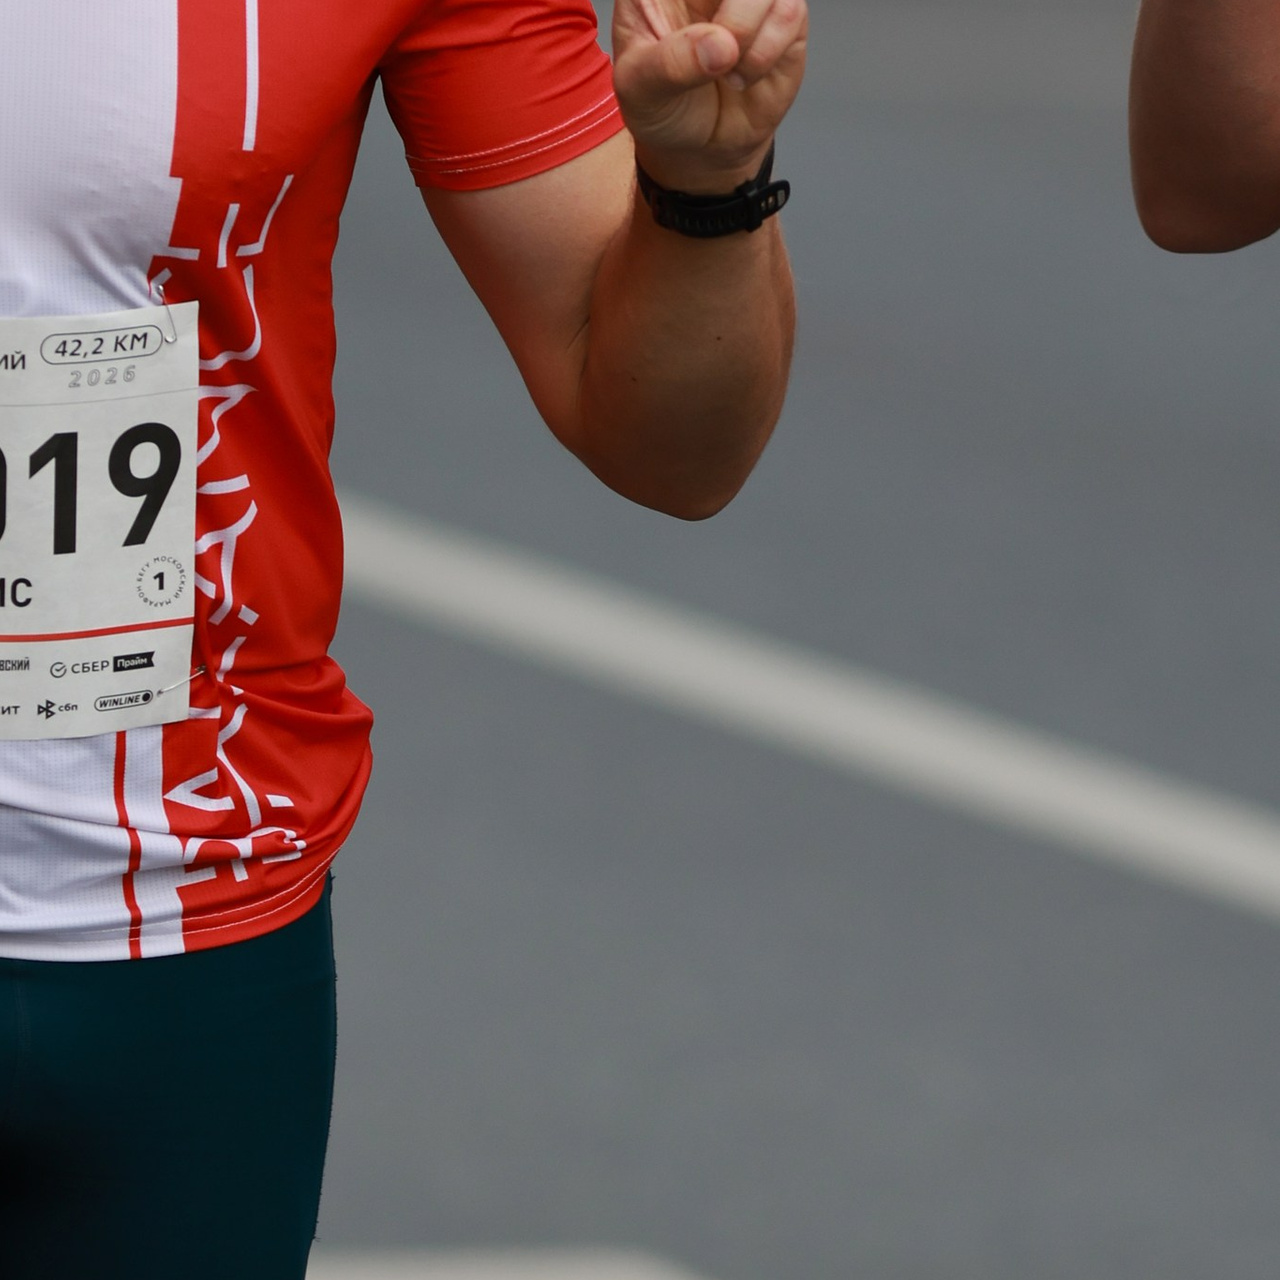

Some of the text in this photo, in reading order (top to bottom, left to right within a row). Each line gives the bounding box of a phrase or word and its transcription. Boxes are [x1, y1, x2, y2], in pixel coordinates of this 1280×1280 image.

[54, 336, 104, 359] 42,2
[153, 571, 164, 591] 1
[71, 656, 148, 674] СБЕР Прайм
[99, 694, 141, 709] WINLINE
